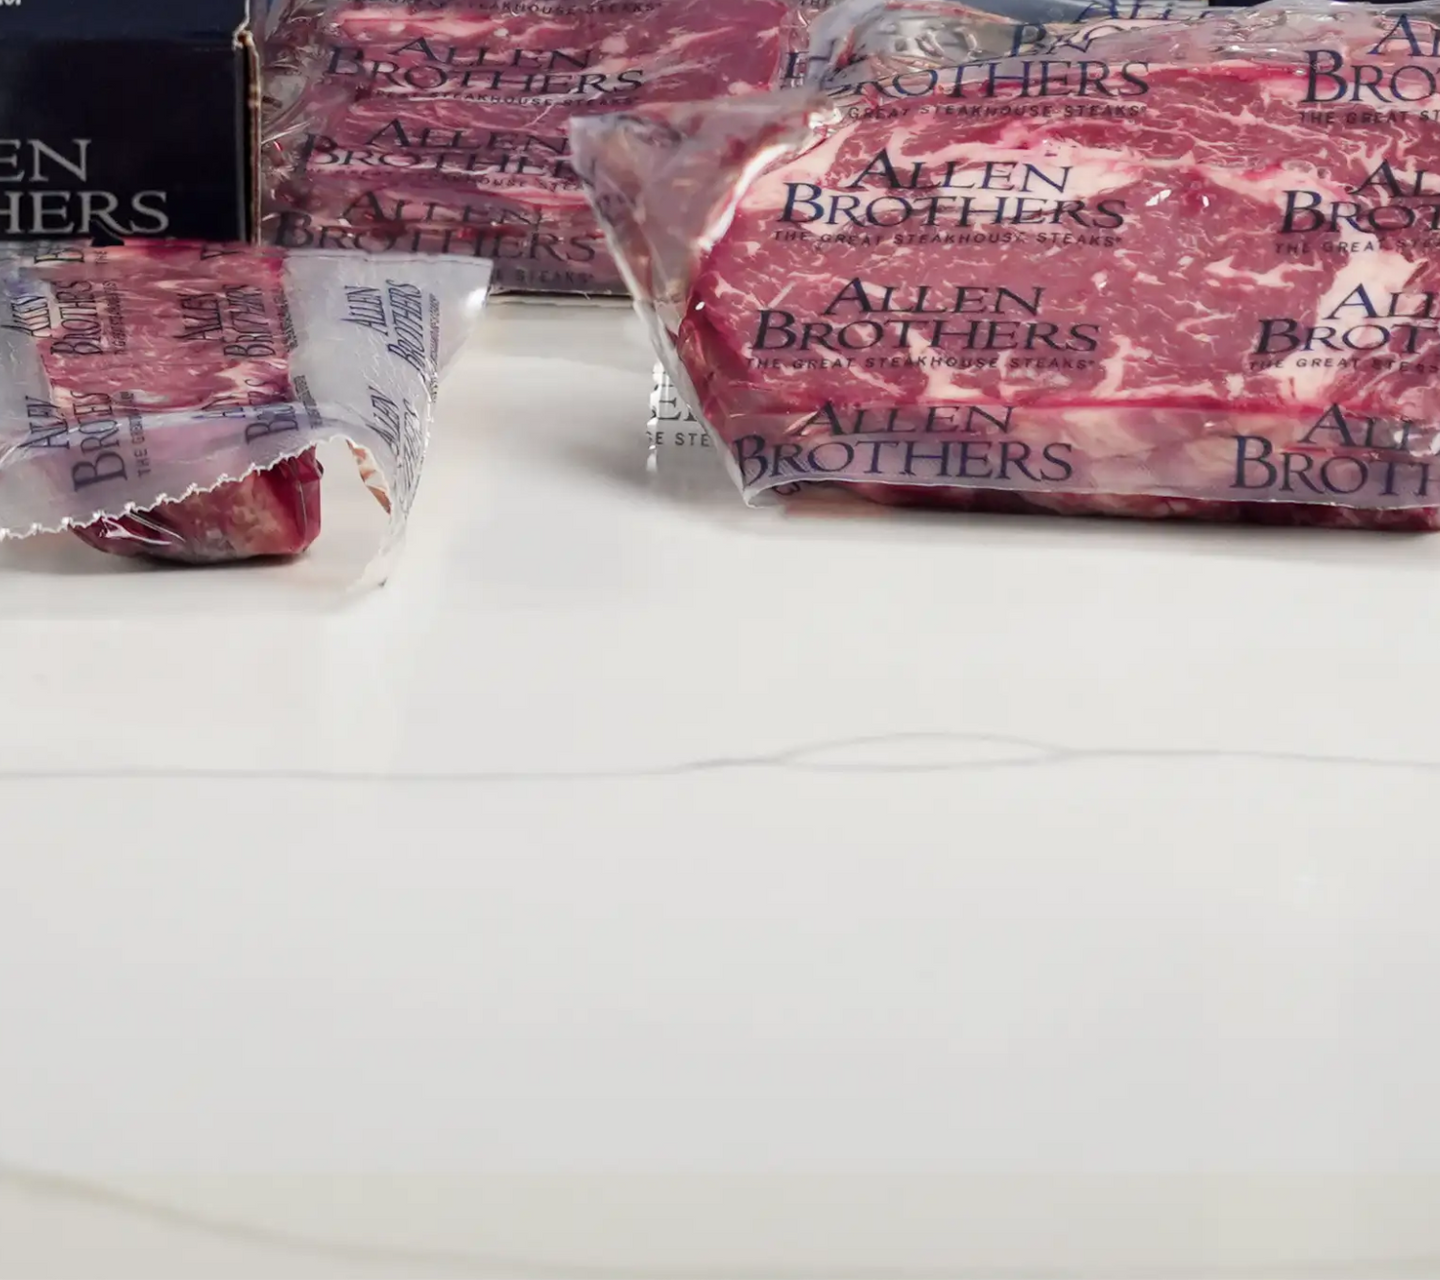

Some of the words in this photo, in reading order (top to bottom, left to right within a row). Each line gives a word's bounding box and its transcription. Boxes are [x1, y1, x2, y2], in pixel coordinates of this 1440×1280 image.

[323, 45, 646, 94] BROTHERS
[391, 35, 594, 72] ALLEN
[824, 60, 1151, 99] ROTHERS
[366, 117, 569, 156] ALLEN
[1298, 110, 1336, 124] THE
[1347, 110, 1411, 124] GREAT
[847, 148, 1073, 193] ALLEN
[344, 190, 543, 225] ALLEN
[777, 181, 1126, 229] BROTHERS
[275, 210, 597, 262] BROTHERS
[340, 285, 389, 336] ALLEN
[823, 276, 1045, 317] ALLEN
[751, 309, 1101, 353] BROTHERS
[746, 357, 782, 370] THE
[792, 357, 856, 370] GREAT
[865, 356, 1000, 370] STEAKHOUSE
[784, 399, 1016, 437] ALLEN
[735, 434, 1074, 485] BROTHERS
